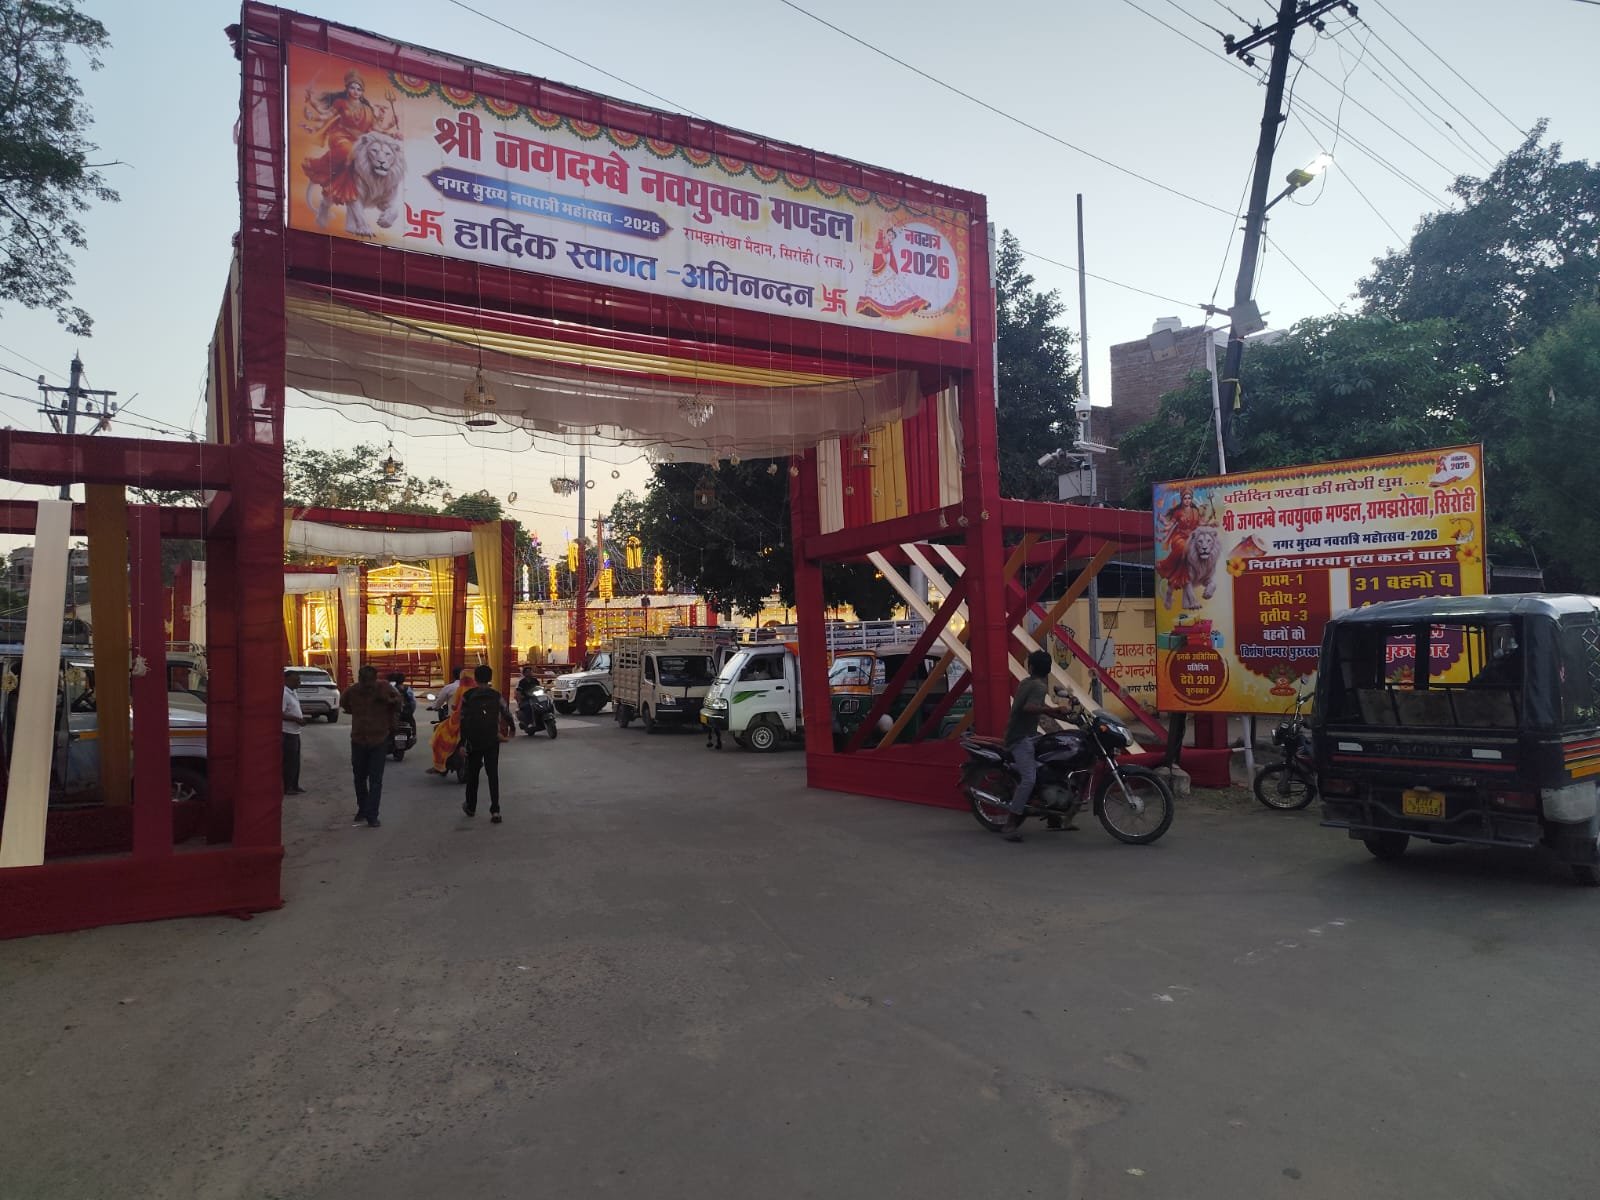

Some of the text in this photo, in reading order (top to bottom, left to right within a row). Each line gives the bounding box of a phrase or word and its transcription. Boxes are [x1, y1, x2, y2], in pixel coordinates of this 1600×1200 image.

[434, 111, 854, 242] श्री जगदम्बे नवयुवक मण्डल
[437, 176, 470, 194] नगर
[472, 183, 508, 202] मुख्य
[454, 217, 558, 260] हार्दिक
[566, 240, 659, 280] स्वागत
[683, 227, 741, 250] रामझरोखा
[780, 244, 814, 265] सिरोही
[904, 228, 941, 250] नवरात्र
[900, 248, 950, 280] 2026
[1224, 488, 1272, 504] प्रतिदिन
[1312, 480, 1333, 494] की
[1335, 476, 1375, 493] मचेगी
[1222, 510, 1235, 532] श्री
[1237, 506, 1276, 530] जगदम्बे
[1278, 506, 1322, 532] नवयुवक
[1272, 540, 1294, 550] नगर
[1296, 537, 1322, 551] मुख्य
[1324, 532, 1360, 547] नवरात्रि
[1248, 558, 1302, 570] नियमित
[1378, 549, 1416, 562] करने
[1418, 547, 1452, 560] वाले
[1355, 576, 1380, 592] 31
[1386, 570, 1435, 590] बहनों
[1263, 626, 1306, 641] बहनों को
[1196, 675, 1216, 685] 200
